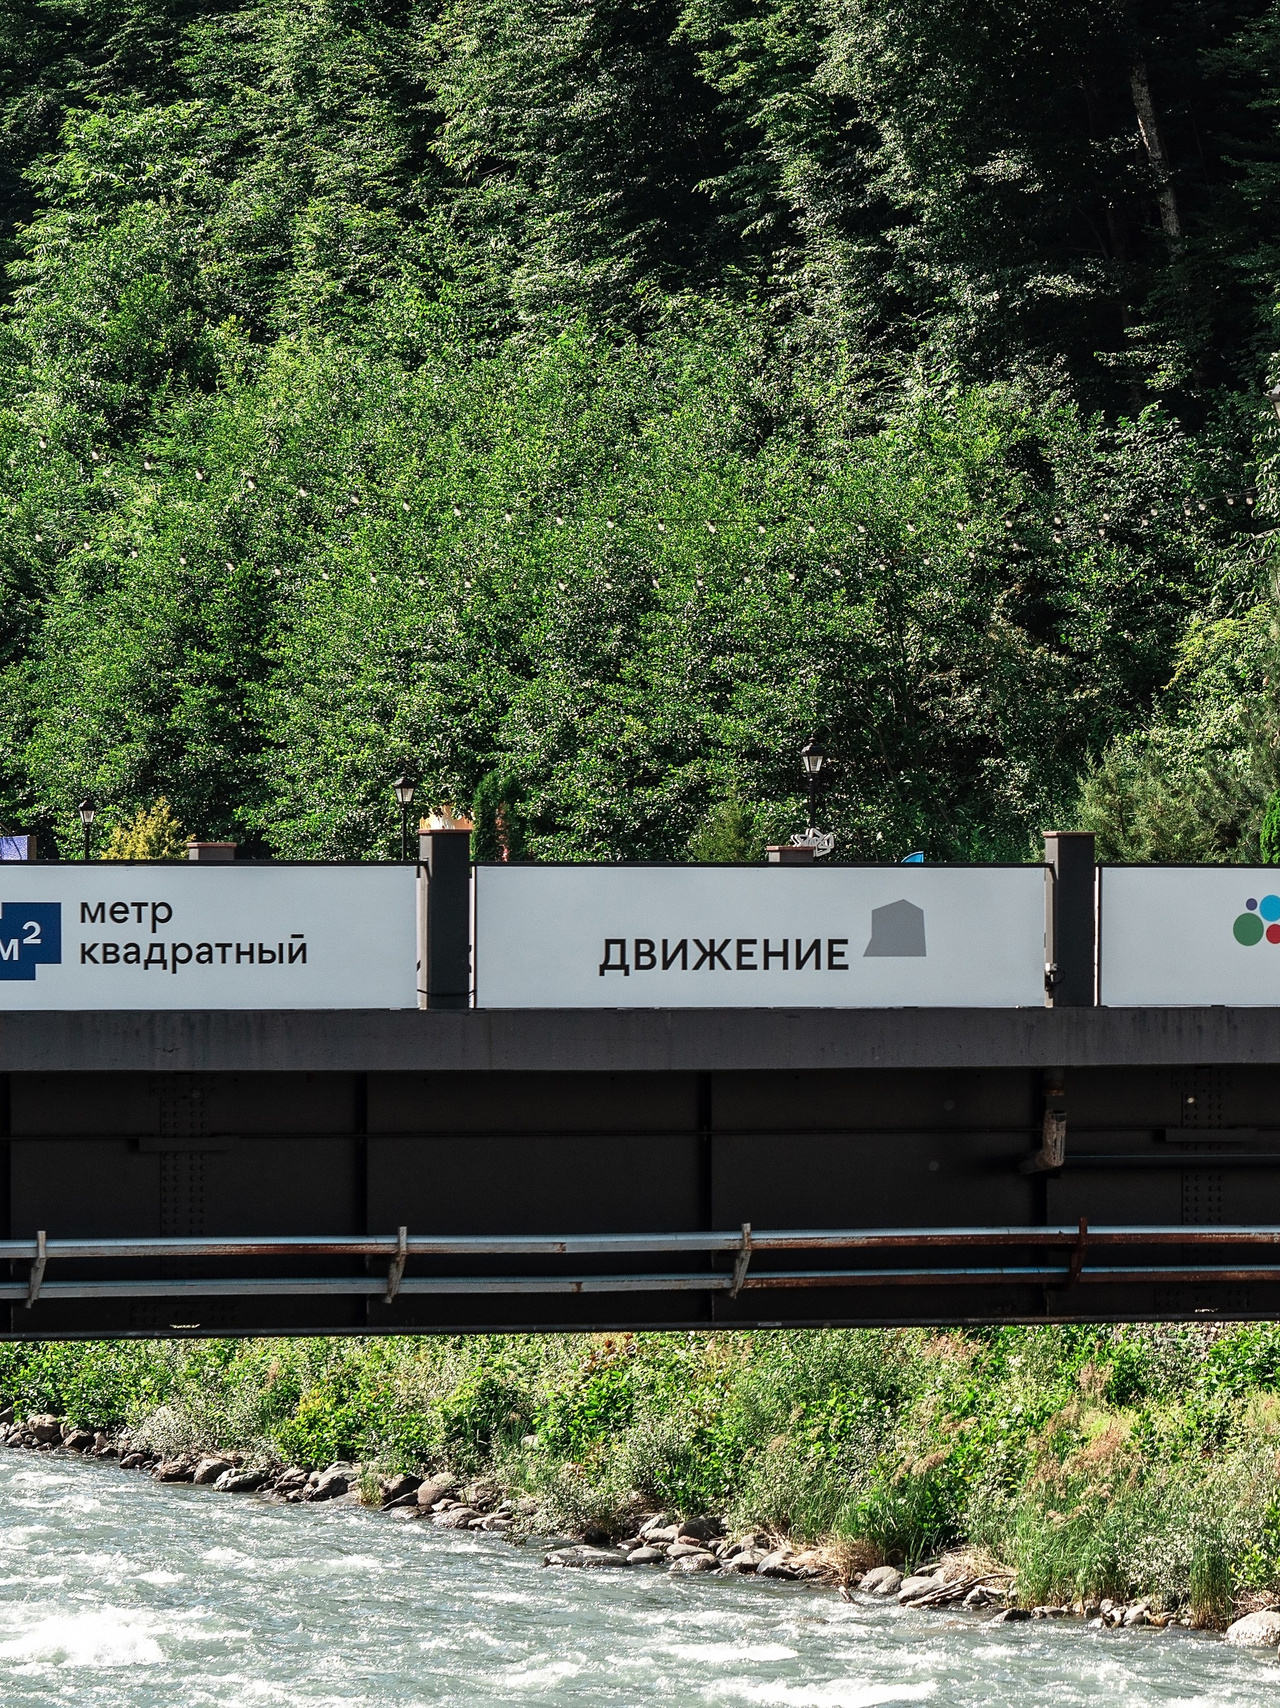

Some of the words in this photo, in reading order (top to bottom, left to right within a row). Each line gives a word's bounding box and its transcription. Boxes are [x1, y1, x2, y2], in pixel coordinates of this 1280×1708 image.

[80, 901, 173, 934] метр
[80, 933, 308, 975] квадратный
[598, 938, 849, 977] ДВИЖЕНИЕ
